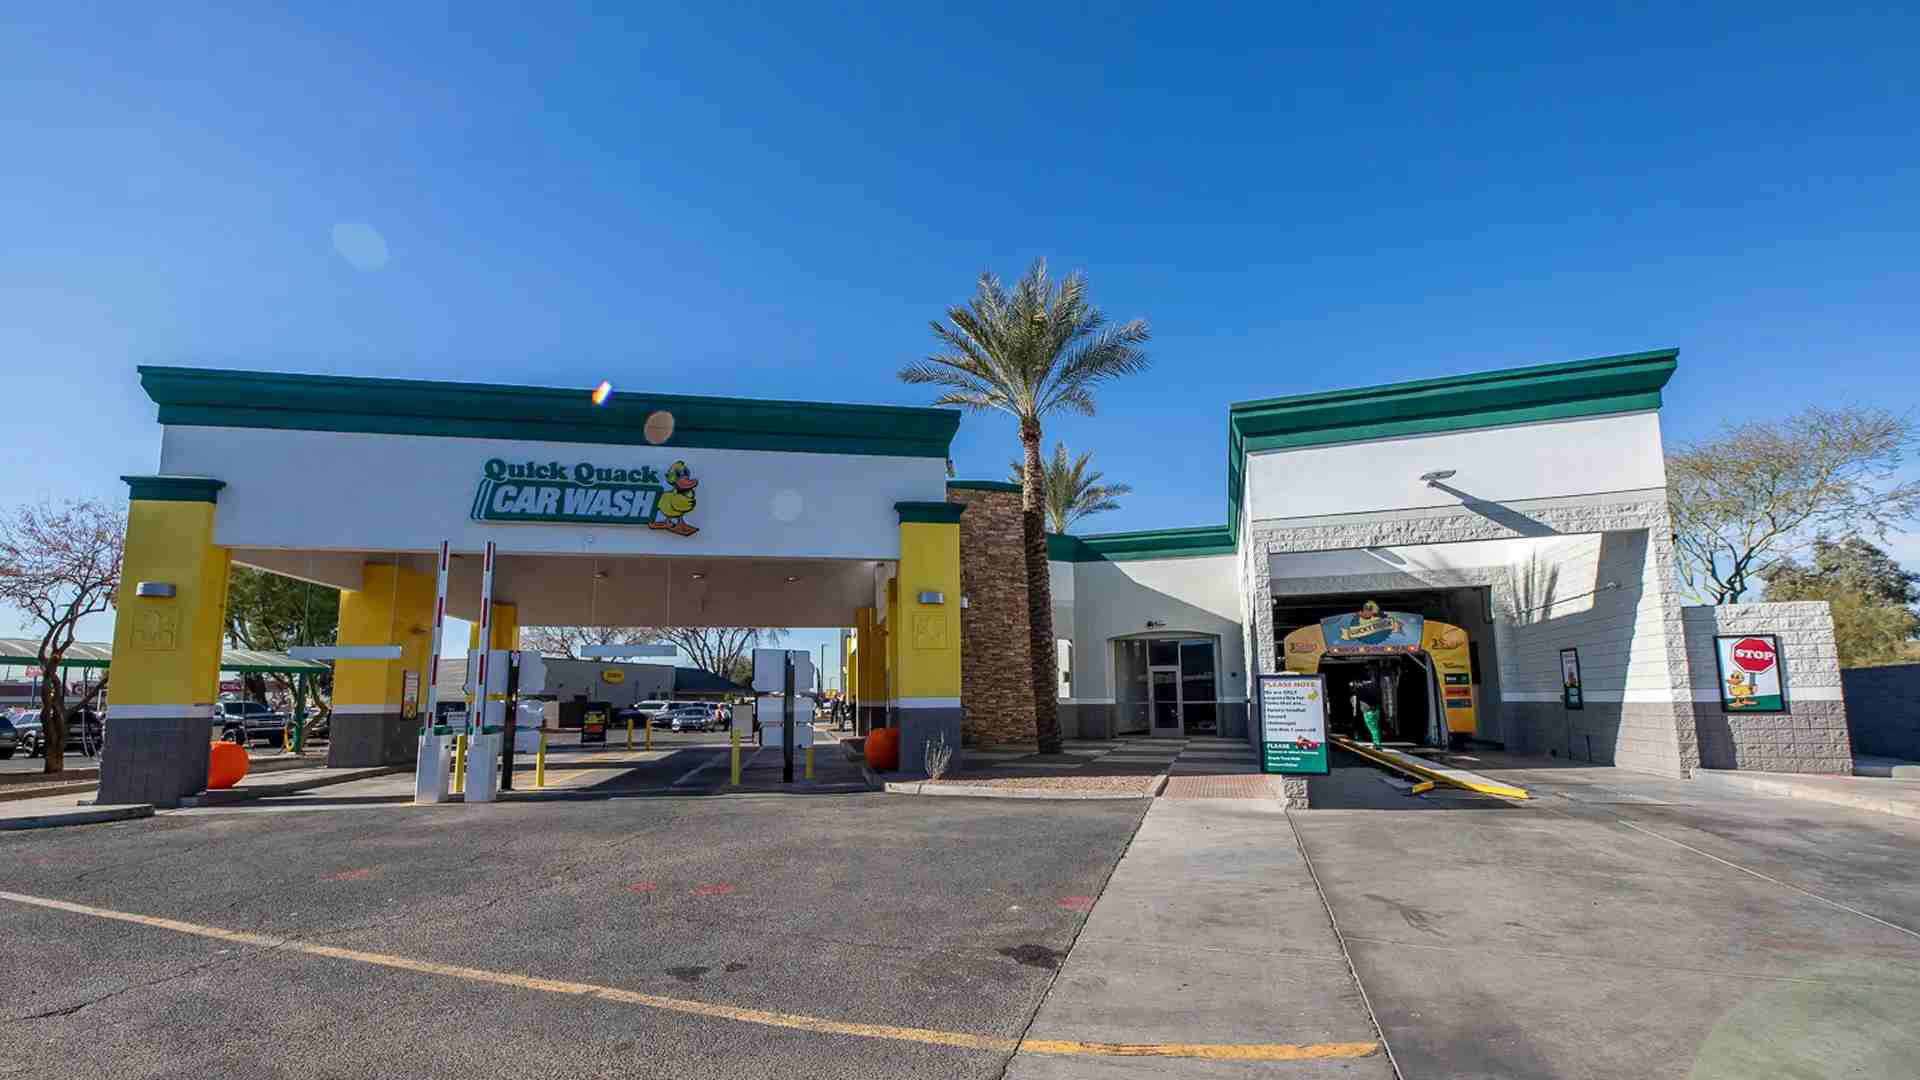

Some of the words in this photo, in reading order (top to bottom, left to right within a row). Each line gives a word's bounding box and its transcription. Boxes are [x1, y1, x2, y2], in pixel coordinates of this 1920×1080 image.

[484, 458, 568, 482] Quick
[574, 462, 660, 485] Quack
[493, 485, 559, 514] CAR
[563, 488, 656, 518] WASH
[1735, 649, 1773, 660] STOP
